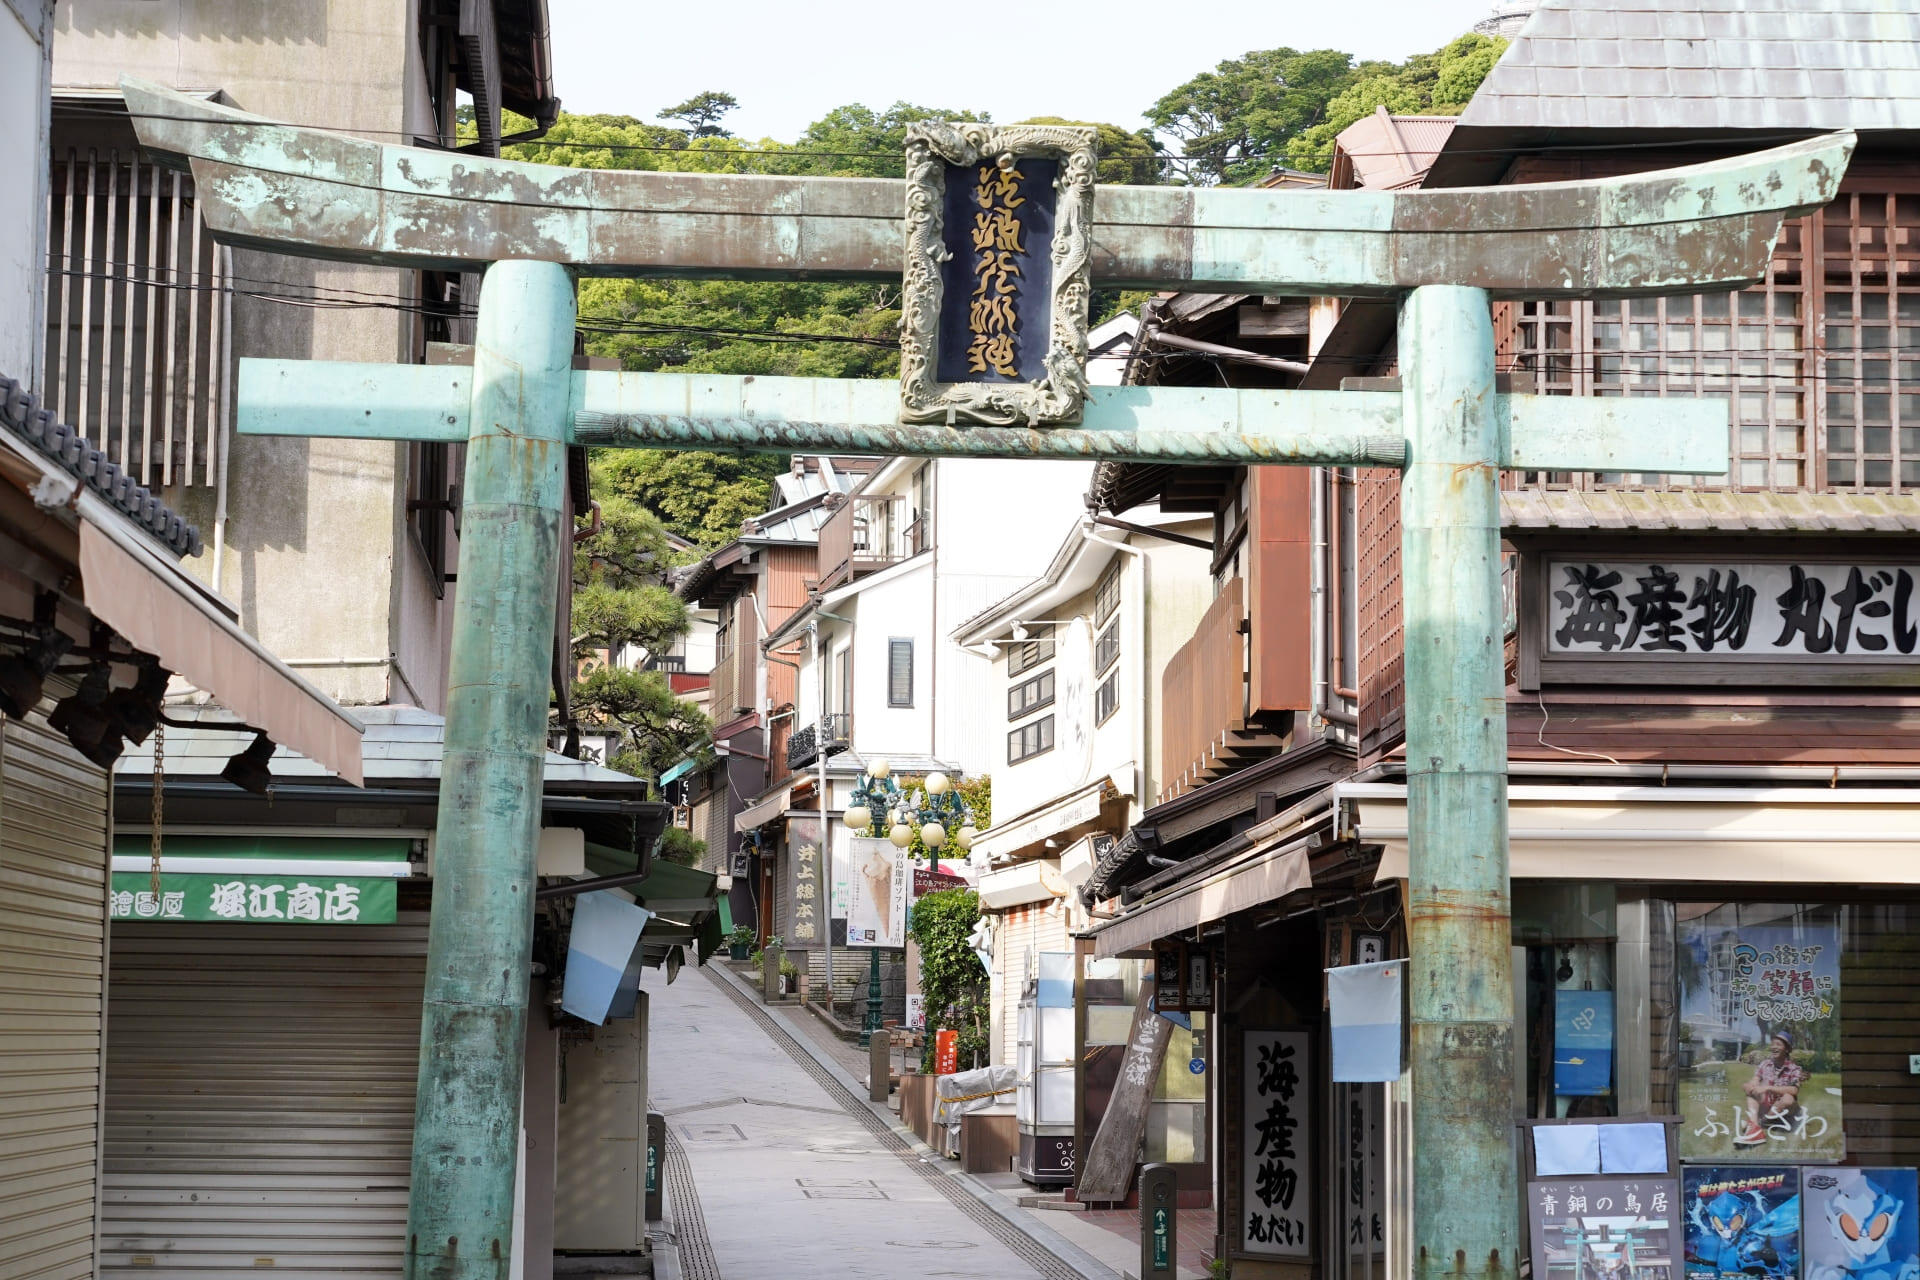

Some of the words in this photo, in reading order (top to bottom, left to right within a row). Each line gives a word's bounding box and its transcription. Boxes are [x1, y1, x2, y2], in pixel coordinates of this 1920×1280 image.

[1554, 564, 1757, 652] 海産物
[894, 846, 904, 912] の島珈琲ソフト
[209, 880, 361, 921] 堀江商店
[1733, 944, 1822, 976] この街が
[1254, 1040, 1300, 1211] 海産物
[1694, 1105, 1828, 1141] ふじさわ
[1540, 1192, 1669, 1216] 青銅の鳥居
[1248, 1212, 1304, 1247] 丸だい
